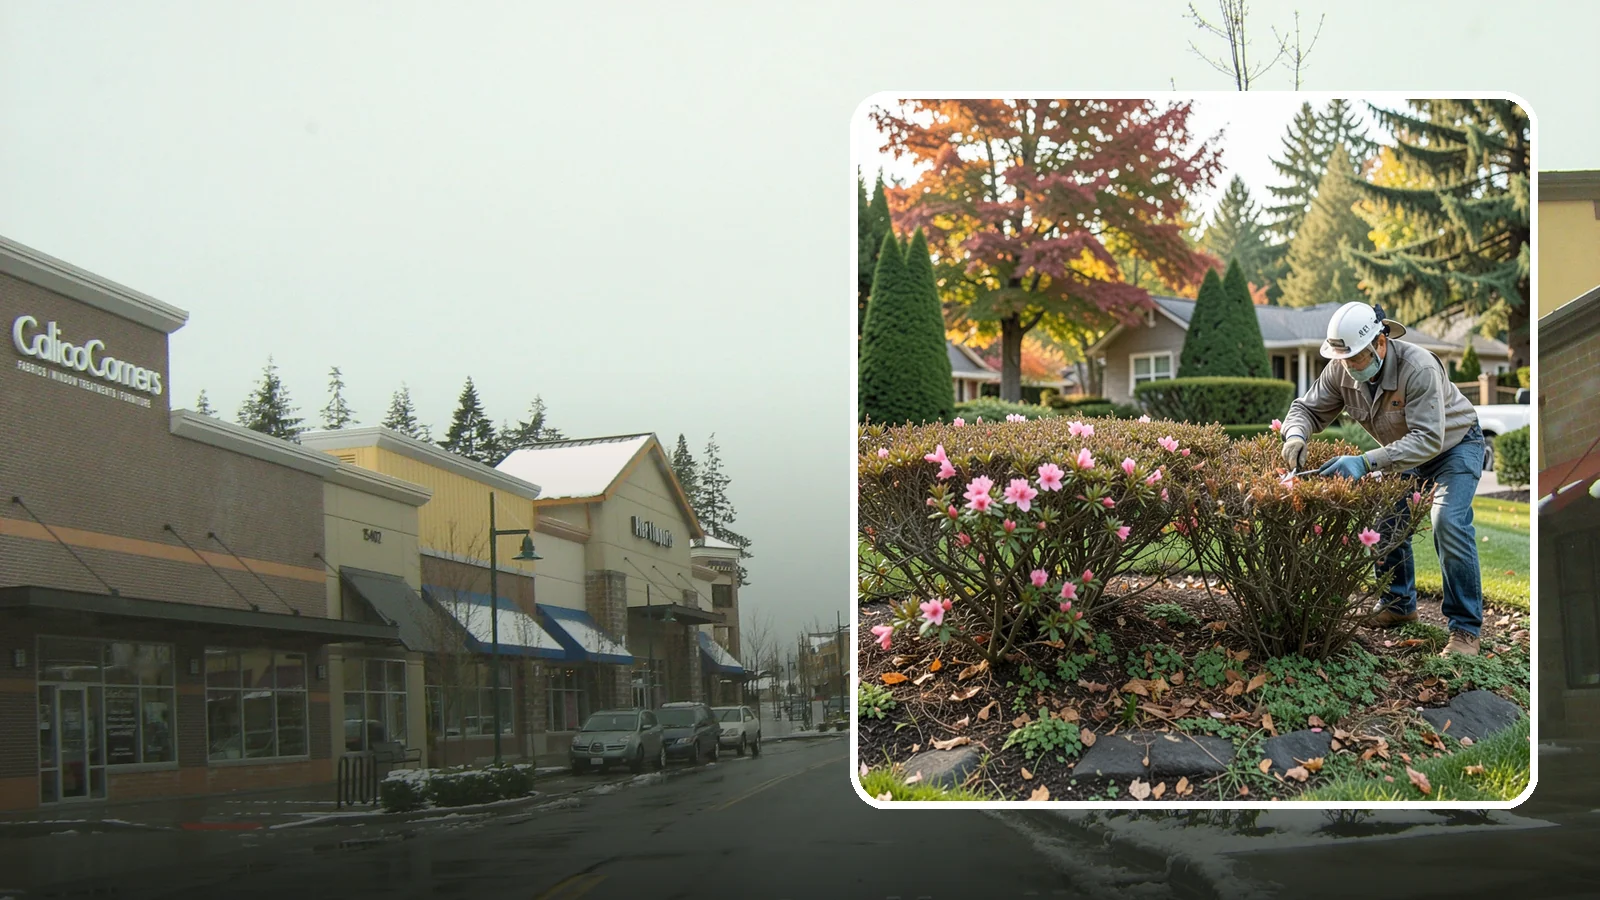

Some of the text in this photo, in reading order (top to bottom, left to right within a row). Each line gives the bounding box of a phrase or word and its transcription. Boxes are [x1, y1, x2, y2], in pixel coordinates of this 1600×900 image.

[17, 359, 151, 409] FABRICS WINDOW TREATMENTS FURNITURE
